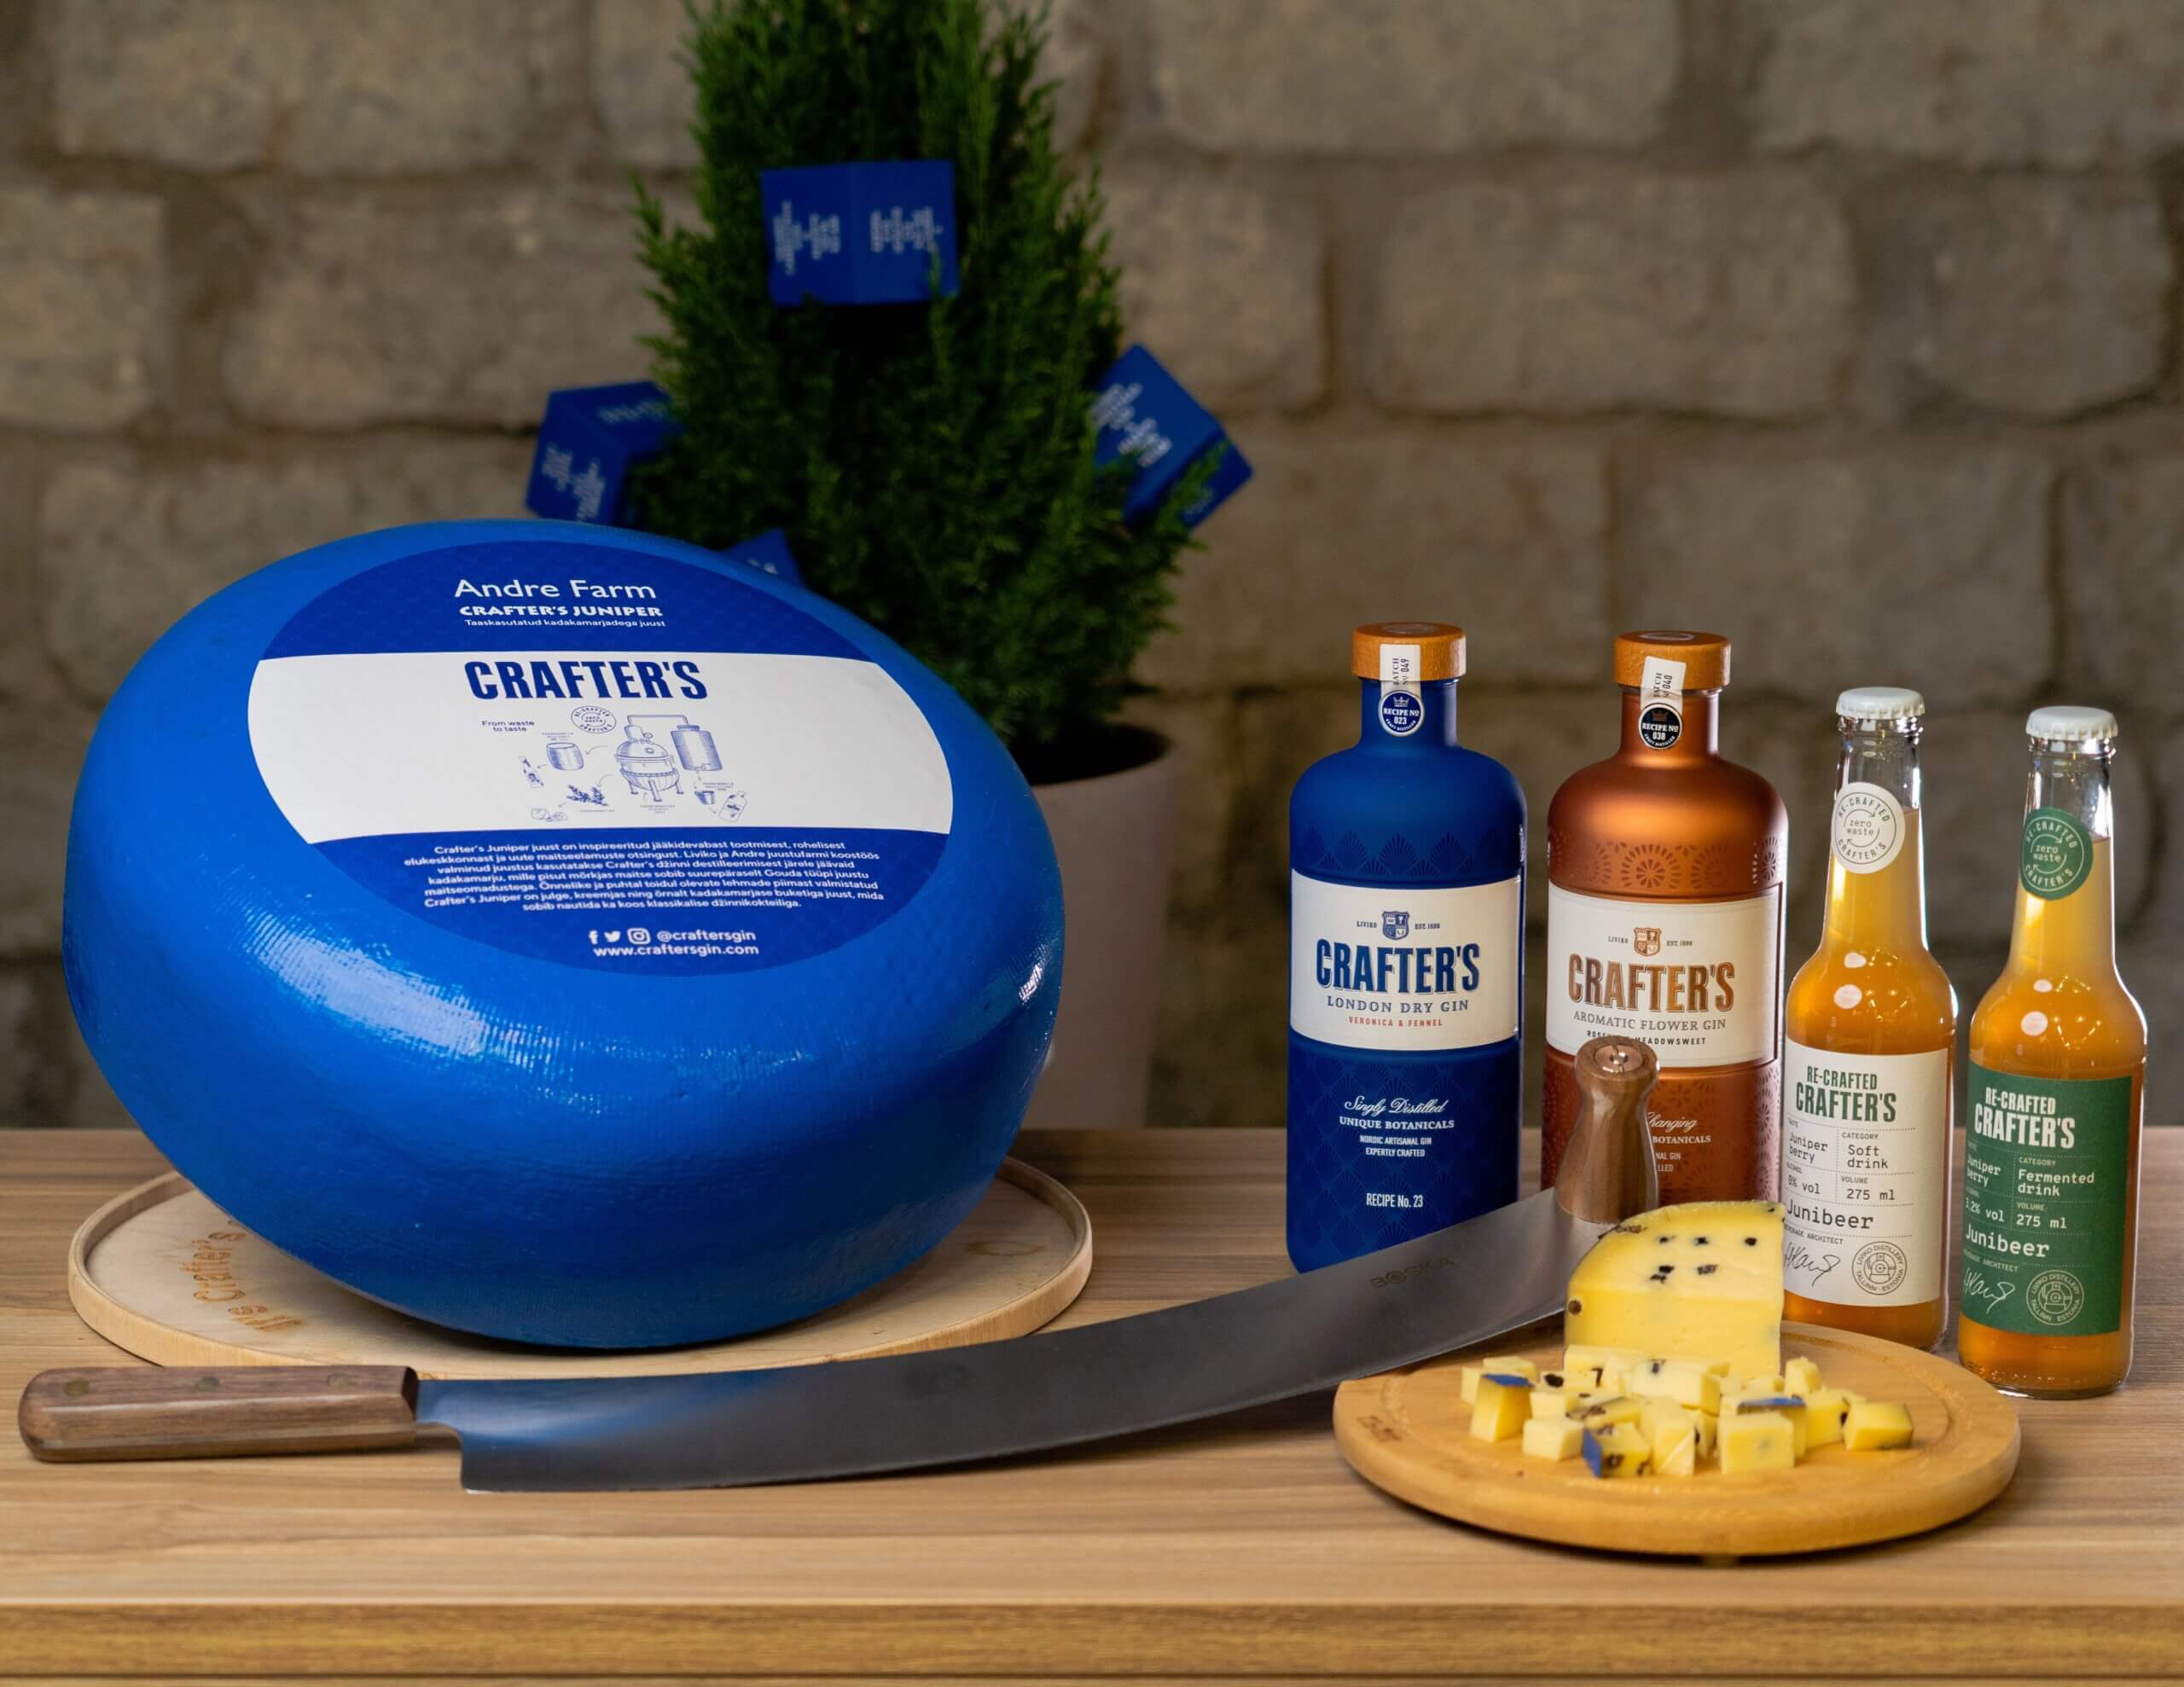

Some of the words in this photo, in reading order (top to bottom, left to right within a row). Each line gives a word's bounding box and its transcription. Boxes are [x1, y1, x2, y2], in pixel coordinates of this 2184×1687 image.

[455, 579, 561, 597] Andre
[570, 579, 656, 598] Farm
[459, 606, 568, 616] CRAFTER'S
[573, 606, 662, 617] JUNIPER
[465, 661, 708, 699] CRAFTER'S
[1383, 708, 1409, 716] RECIPE
[1393, 716, 1407, 725] 023
[1642, 722, 1668, 732] RECIPE
[1653, 732, 1666, 740] 038
[1847, 827, 1874, 836] waste
[434, 845, 485, 854] Crafter's
[486, 844, 528, 853] Juniper
[531, 844, 560, 852] juust
[719, 850, 729, 859] ja
[767, 850, 829, 859] juustufarmi
[1838, 838, 1886, 860] CRAFTER'S
[2034, 853, 2060, 862] waste
[437, 864, 491, 873] valminud
[492, 864, 534, 873] juustus
[605, 861, 655, 869] Crafter's
[508, 873, 536, 882] mille
[537, 872, 566, 881] pisut
[834, 871, 868, 879] juustu
[594, 881, 604, 890] ja
[773, 879, 812, 888] piimast
[815, 880, 878, 890] valmistatud
[424, 896, 475, 907] Crafter's
[478, 895, 520, 903] Juniper
[627, 890, 653, 900] ning
[775, 890, 823, 898] buketiga
[857, 891, 884, 900] mida
[522, 902, 555, 911] sobib
[618, 900, 645, 908] koos
[647, 899, 709, 907] klassikalise
[657, 930, 756, 942] @craftersgin
[594, 944, 759, 957] www.craftersgin.com
[1316, 939, 1480, 994] CRAFTER'S
[1568, 953, 1735, 1012] CRAFTER'S
[1327, 996, 1392, 1012] LONDON
[1400, 1002, 1433, 1013] DRY
[1440, 1000, 1469, 1012] GIN
[1349, 1016, 1393, 1027] VERONICA
[1408, 1018, 1443, 1027] FENNEL
[1573, 1010, 1636, 1029] AROMATIC
[1641, 1020, 1699, 1031] FLOWER
[1703, 1018, 1727, 1030] GIN
[1807, 1065, 1878, 1090] RE-CRAFTED
[1345, 1095, 1385, 1116] Singly
[1388, 1098, 1449, 1113] Distilled
[1796, 1081, 1896, 1122] CRAFTER'S
[1985, 1087, 2056, 1115] RE-CRAFTED
[1339, 1116, 1382, 1129] UNIQUE
[1385, 1120, 1455, 1130] BOTANICALS
[1974, 1103, 2076, 1149] CRAFTER'S
[1360, 1134, 1384, 1145] NORDIC
[1384, 1137, 1419, 1145] ARTISANAL
[1652, 1135, 1711, 1144] BOTANICALS
[1790, 1133, 1828, 1152] Juniper
[1366, 1147, 1396, 1157] EXPERTLY
[1397, 1148, 1426, 1157] CRAFTED
[1789, 1145, 1815, 1164] berry
[1848, 1145, 1879, 1157] Soft
[1847, 1158, 1889, 1169] drink
[1967, 1153, 2001, 1175] Juniper
[2018, 1157, 2056, 1167] CATEGORY
[1841, 1175, 1868, 1184] VOLUME
[1966, 1166, 1989, 1187] berry
[2018, 1168, 2094, 1184] Fermented
[1802, 1183, 1820, 1194] vol
[1846, 1188, 1870, 1200] 275
[1879, 1189, 1895, 1200] ml
[2018, 1183, 2060, 1197] drink
[1366, 1193, 1396, 1208] RECIPE
[1397, 1195, 1411, 1208] No.
[1413, 1195, 1423, 1208] 23
[2016, 1202, 2045, 1211] VOLUME
[1787, 1199, 1873, 1229] Junibeer
[1985, 1209, 2004, 1221] vol
[2016, 1214, 2041, 1227] 275
[2050, 1217, 2066, 1228] ml
[1807, 1233, 1844, 1245] ARCHITECT
[1966, 1223, 2049, 1257] Junibeer
[1873, 1244, 1903, 1264] DISTILLERY
[1983, 1259, 2018, 1272] ARCHITECT
[1856, 1270, 1878, 1292] TALLINN
[1882, 1268, 1904, 1291] ESTONIA
